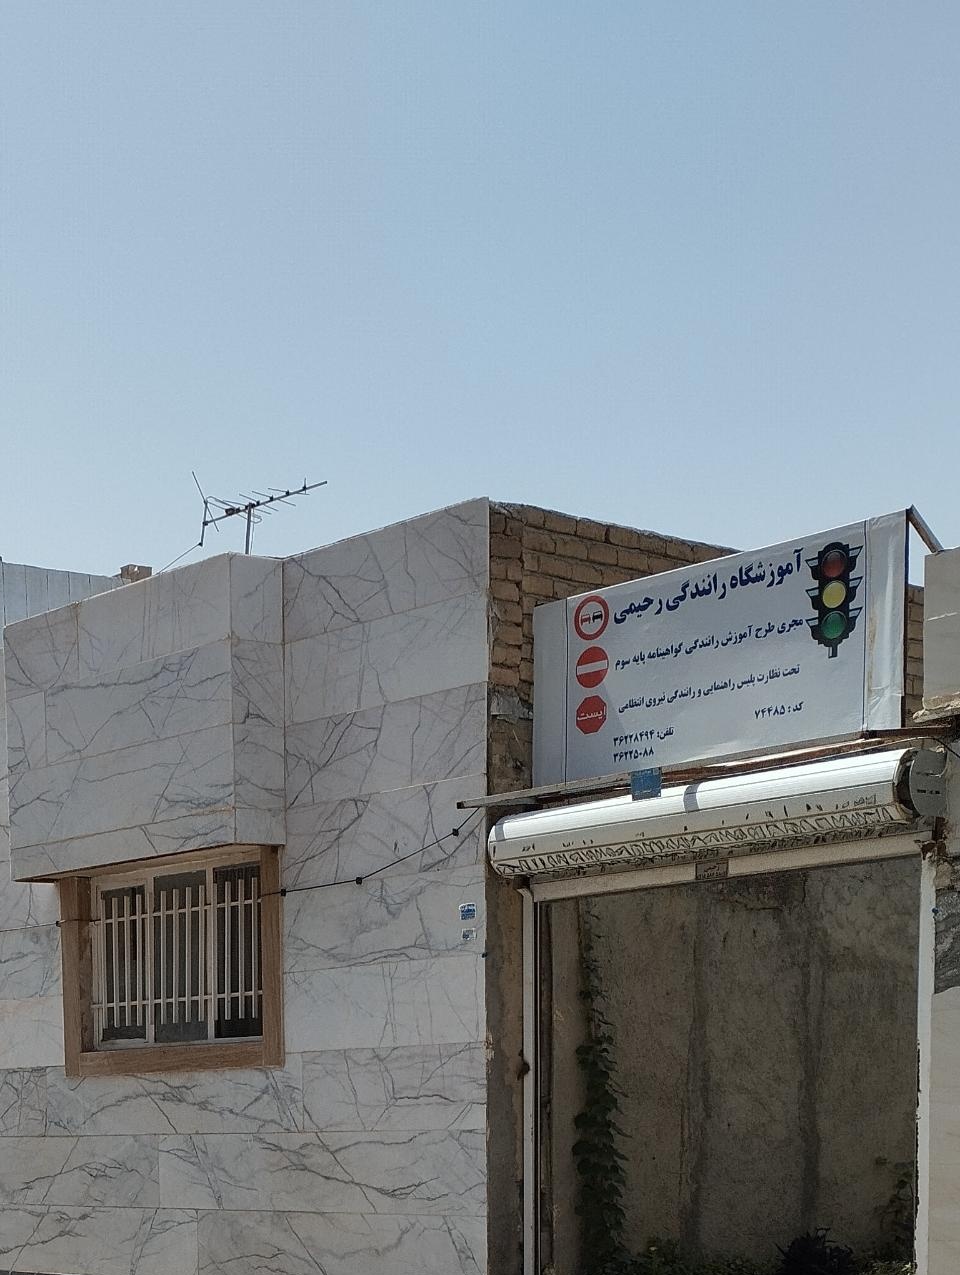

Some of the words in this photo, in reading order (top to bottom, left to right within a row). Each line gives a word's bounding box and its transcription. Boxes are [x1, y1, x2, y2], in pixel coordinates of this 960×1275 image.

[729, 547, 804, 588] آموزشگاه
[666, 572, 727, 612] رانندگی
[613, 596, 662, 625] رحیمی
[754, 622, 775, 639] طرح
[777, 618, 804, 634] مجری
[720, 625, 753, 646] آموزش
[647, 642, 683, 660] گواهینامه
[685, 635, 720, 655] رانندگی
[615, 658, 631, 670] سوم
[632, 651, 646, 666] پایه
[756, 667, 781, 684] نظارت
[782, 664, 800, 677] تحت
[702, 678, 736, 696] راهنمایی
[736, 674, 756, 690] پلیس
[645, 691, 666, 708] نیروی
[666, 686, 696, 704] رانندگی
[577, 705, 606, 721] ایست
[618, 696, 644, 713] انتظامی
[656, 726, 675, 740] تلفن:
